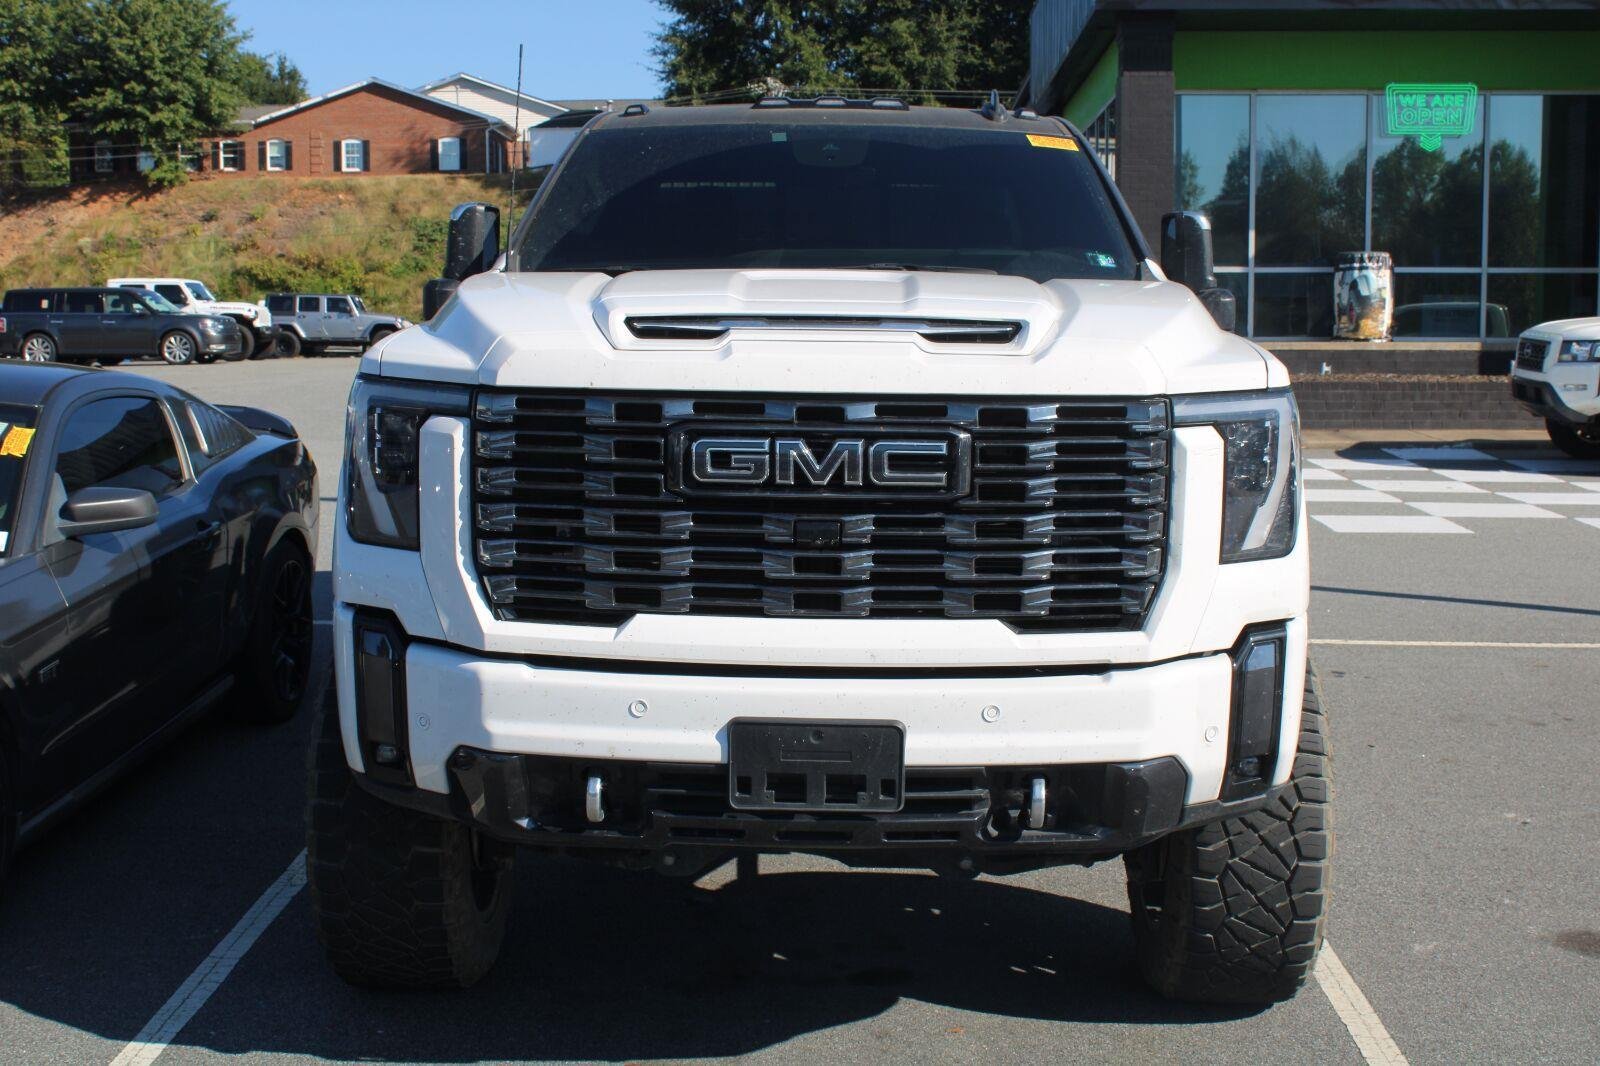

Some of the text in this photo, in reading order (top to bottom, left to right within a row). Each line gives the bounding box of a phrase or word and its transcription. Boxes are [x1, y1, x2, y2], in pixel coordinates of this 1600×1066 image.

[1399, 94, 1465, 107] WE ARE
[1401, 107, 1463, 125] OPEN
[692, 438, 948, 486] GMC
